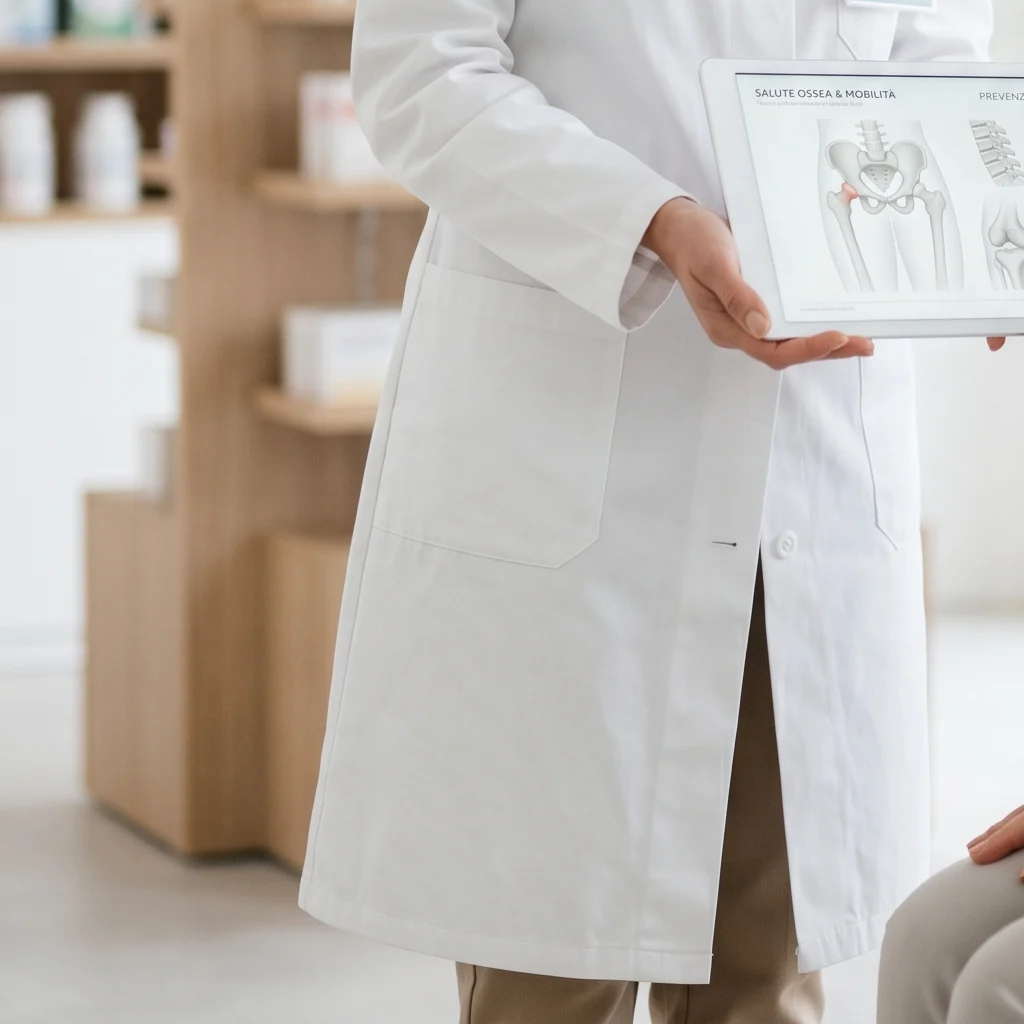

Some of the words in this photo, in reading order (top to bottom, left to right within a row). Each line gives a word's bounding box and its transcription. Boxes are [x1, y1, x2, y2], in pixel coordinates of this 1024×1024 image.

[755, 89, 795, 98] SALUTE
[797, 89, 833, 98] OSSEA
[836, 90, 843, 98] &
[845, 89, 896, 99] MOBILITÀ
